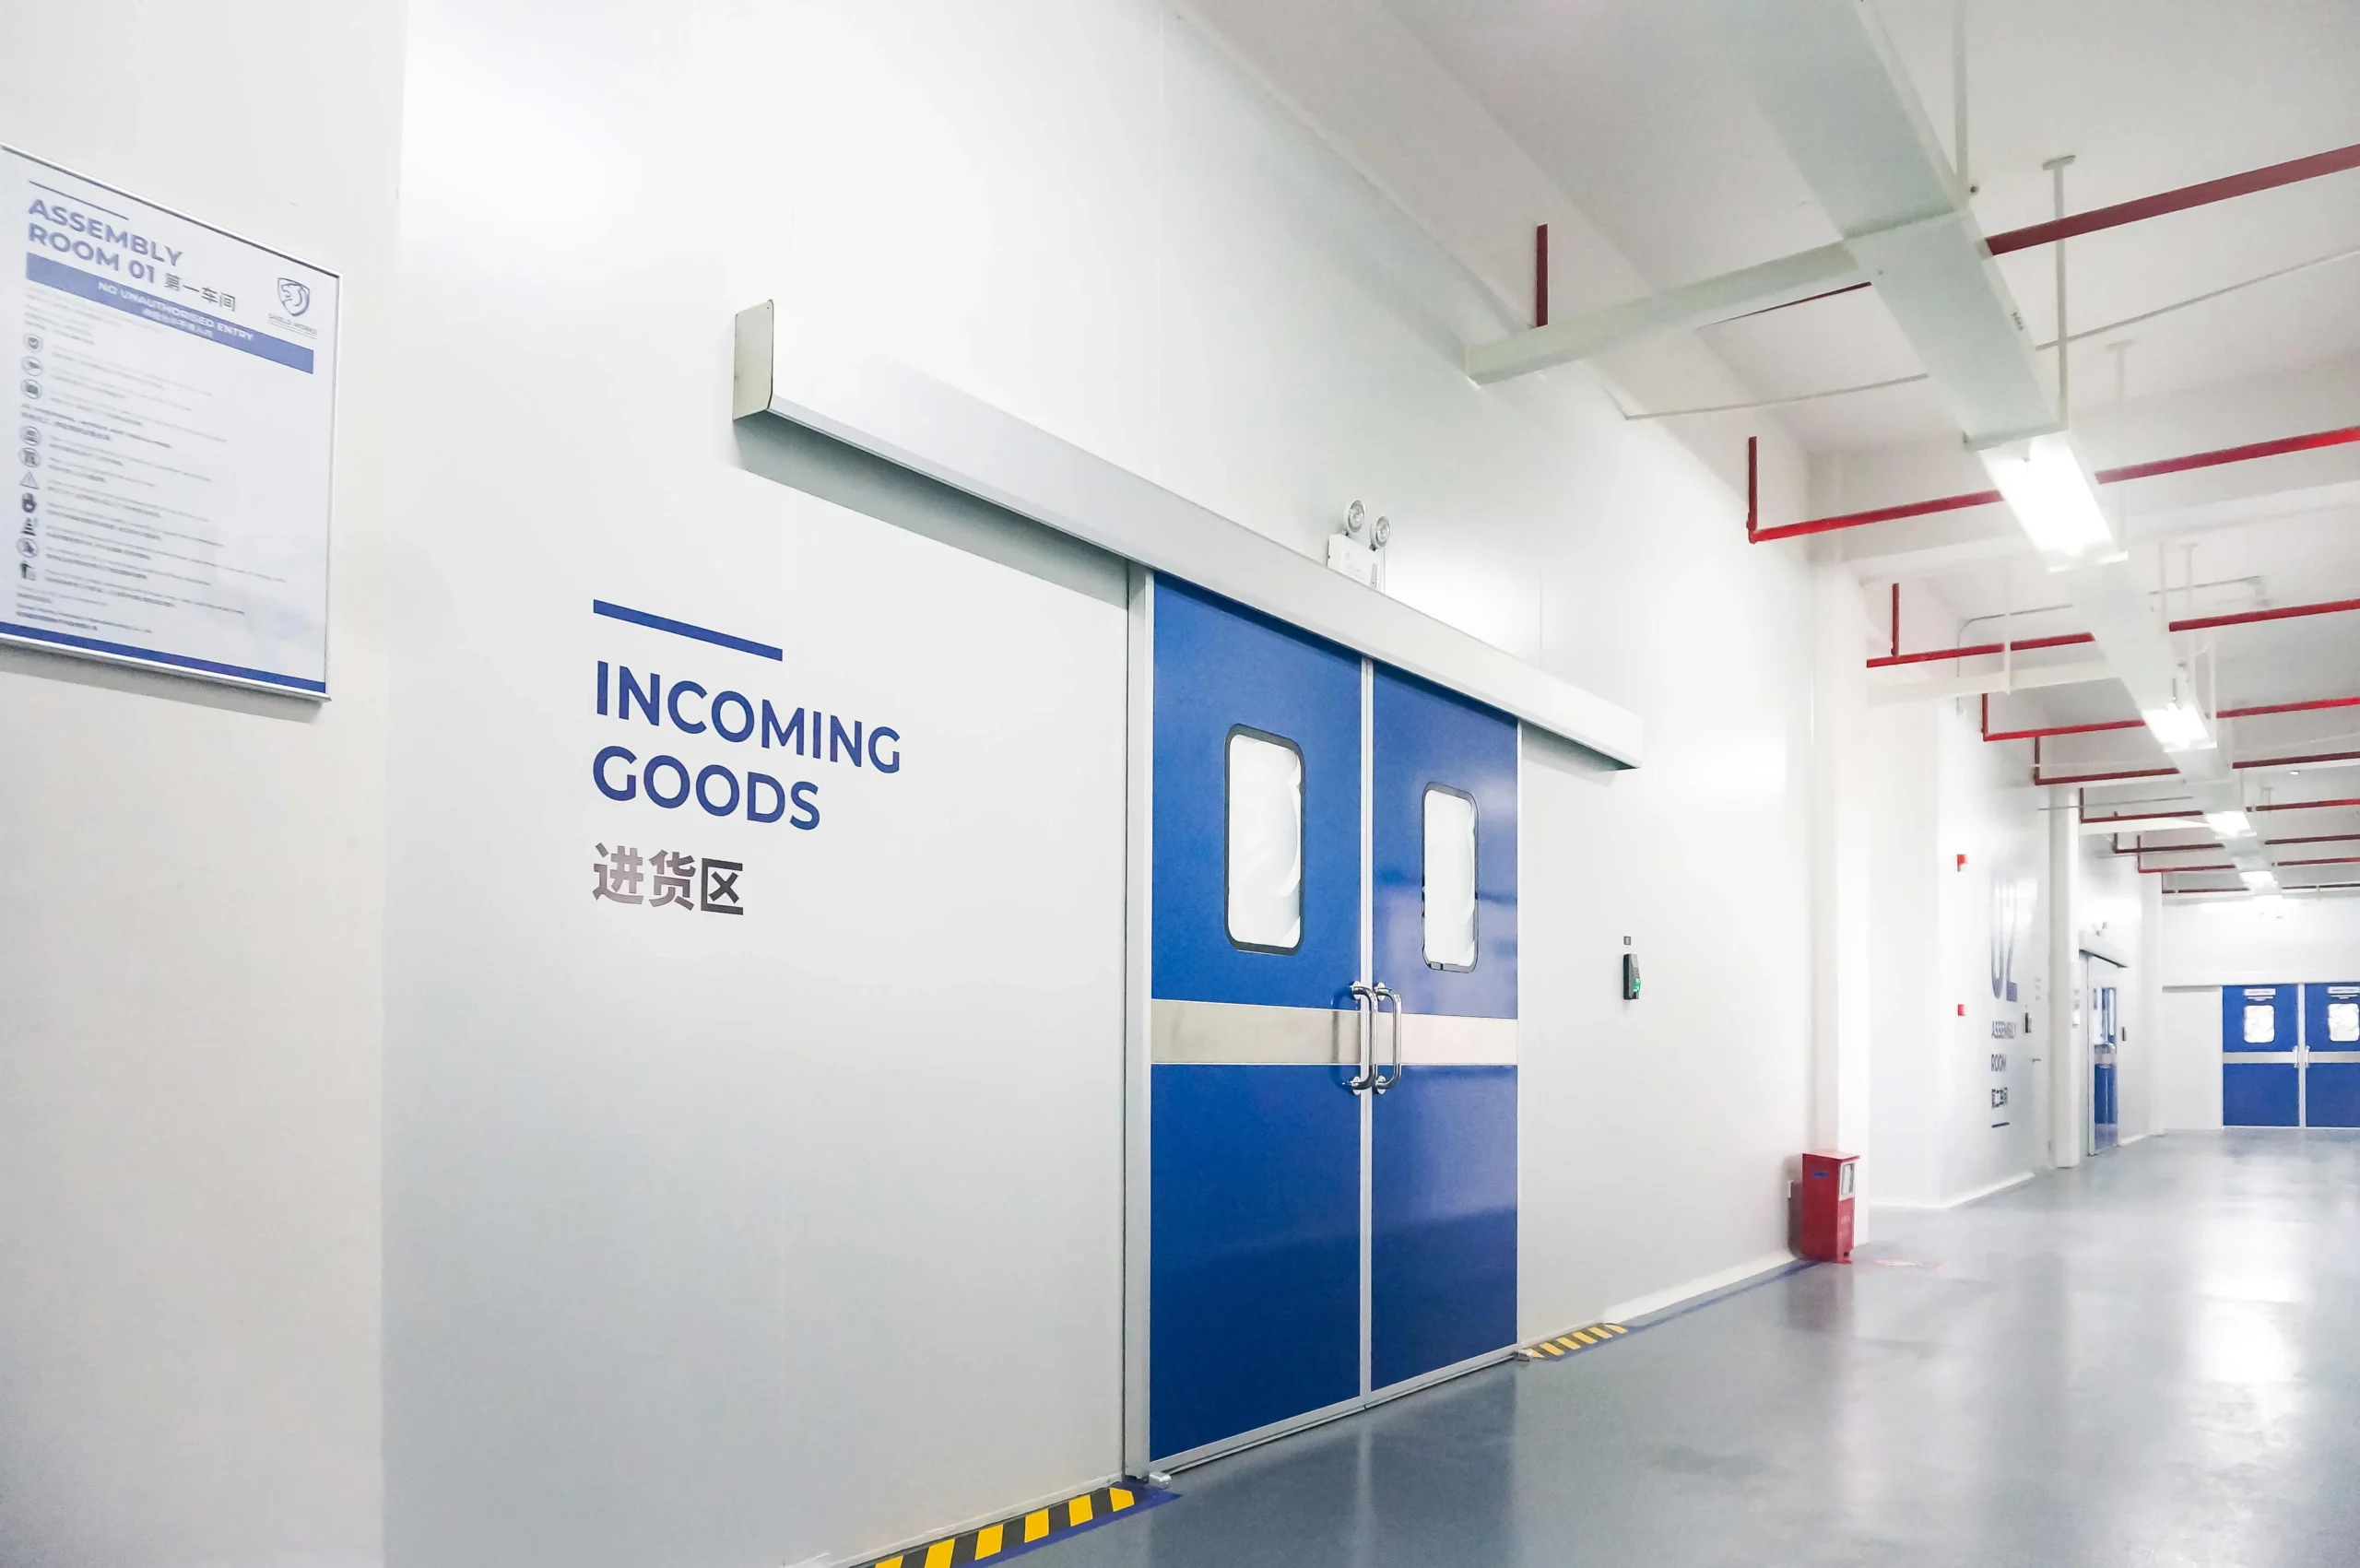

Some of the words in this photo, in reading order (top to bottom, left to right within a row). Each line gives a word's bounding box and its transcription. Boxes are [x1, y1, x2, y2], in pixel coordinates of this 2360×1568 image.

[28, 198, 183, 267] ASSEMBLY
[28, 222, 120, 272] ROOM
[128, 260, 155, 284] 01
[98, 280, 118, 296] NO
[217, 324, 255, 341] ENTRY
[164, 272, 236, 312] 第一车间
[596, 660, 901, 773] INCOMING
[593, 745, 820, 831] GOODS
[592, 842, 744, 915] 进货区
